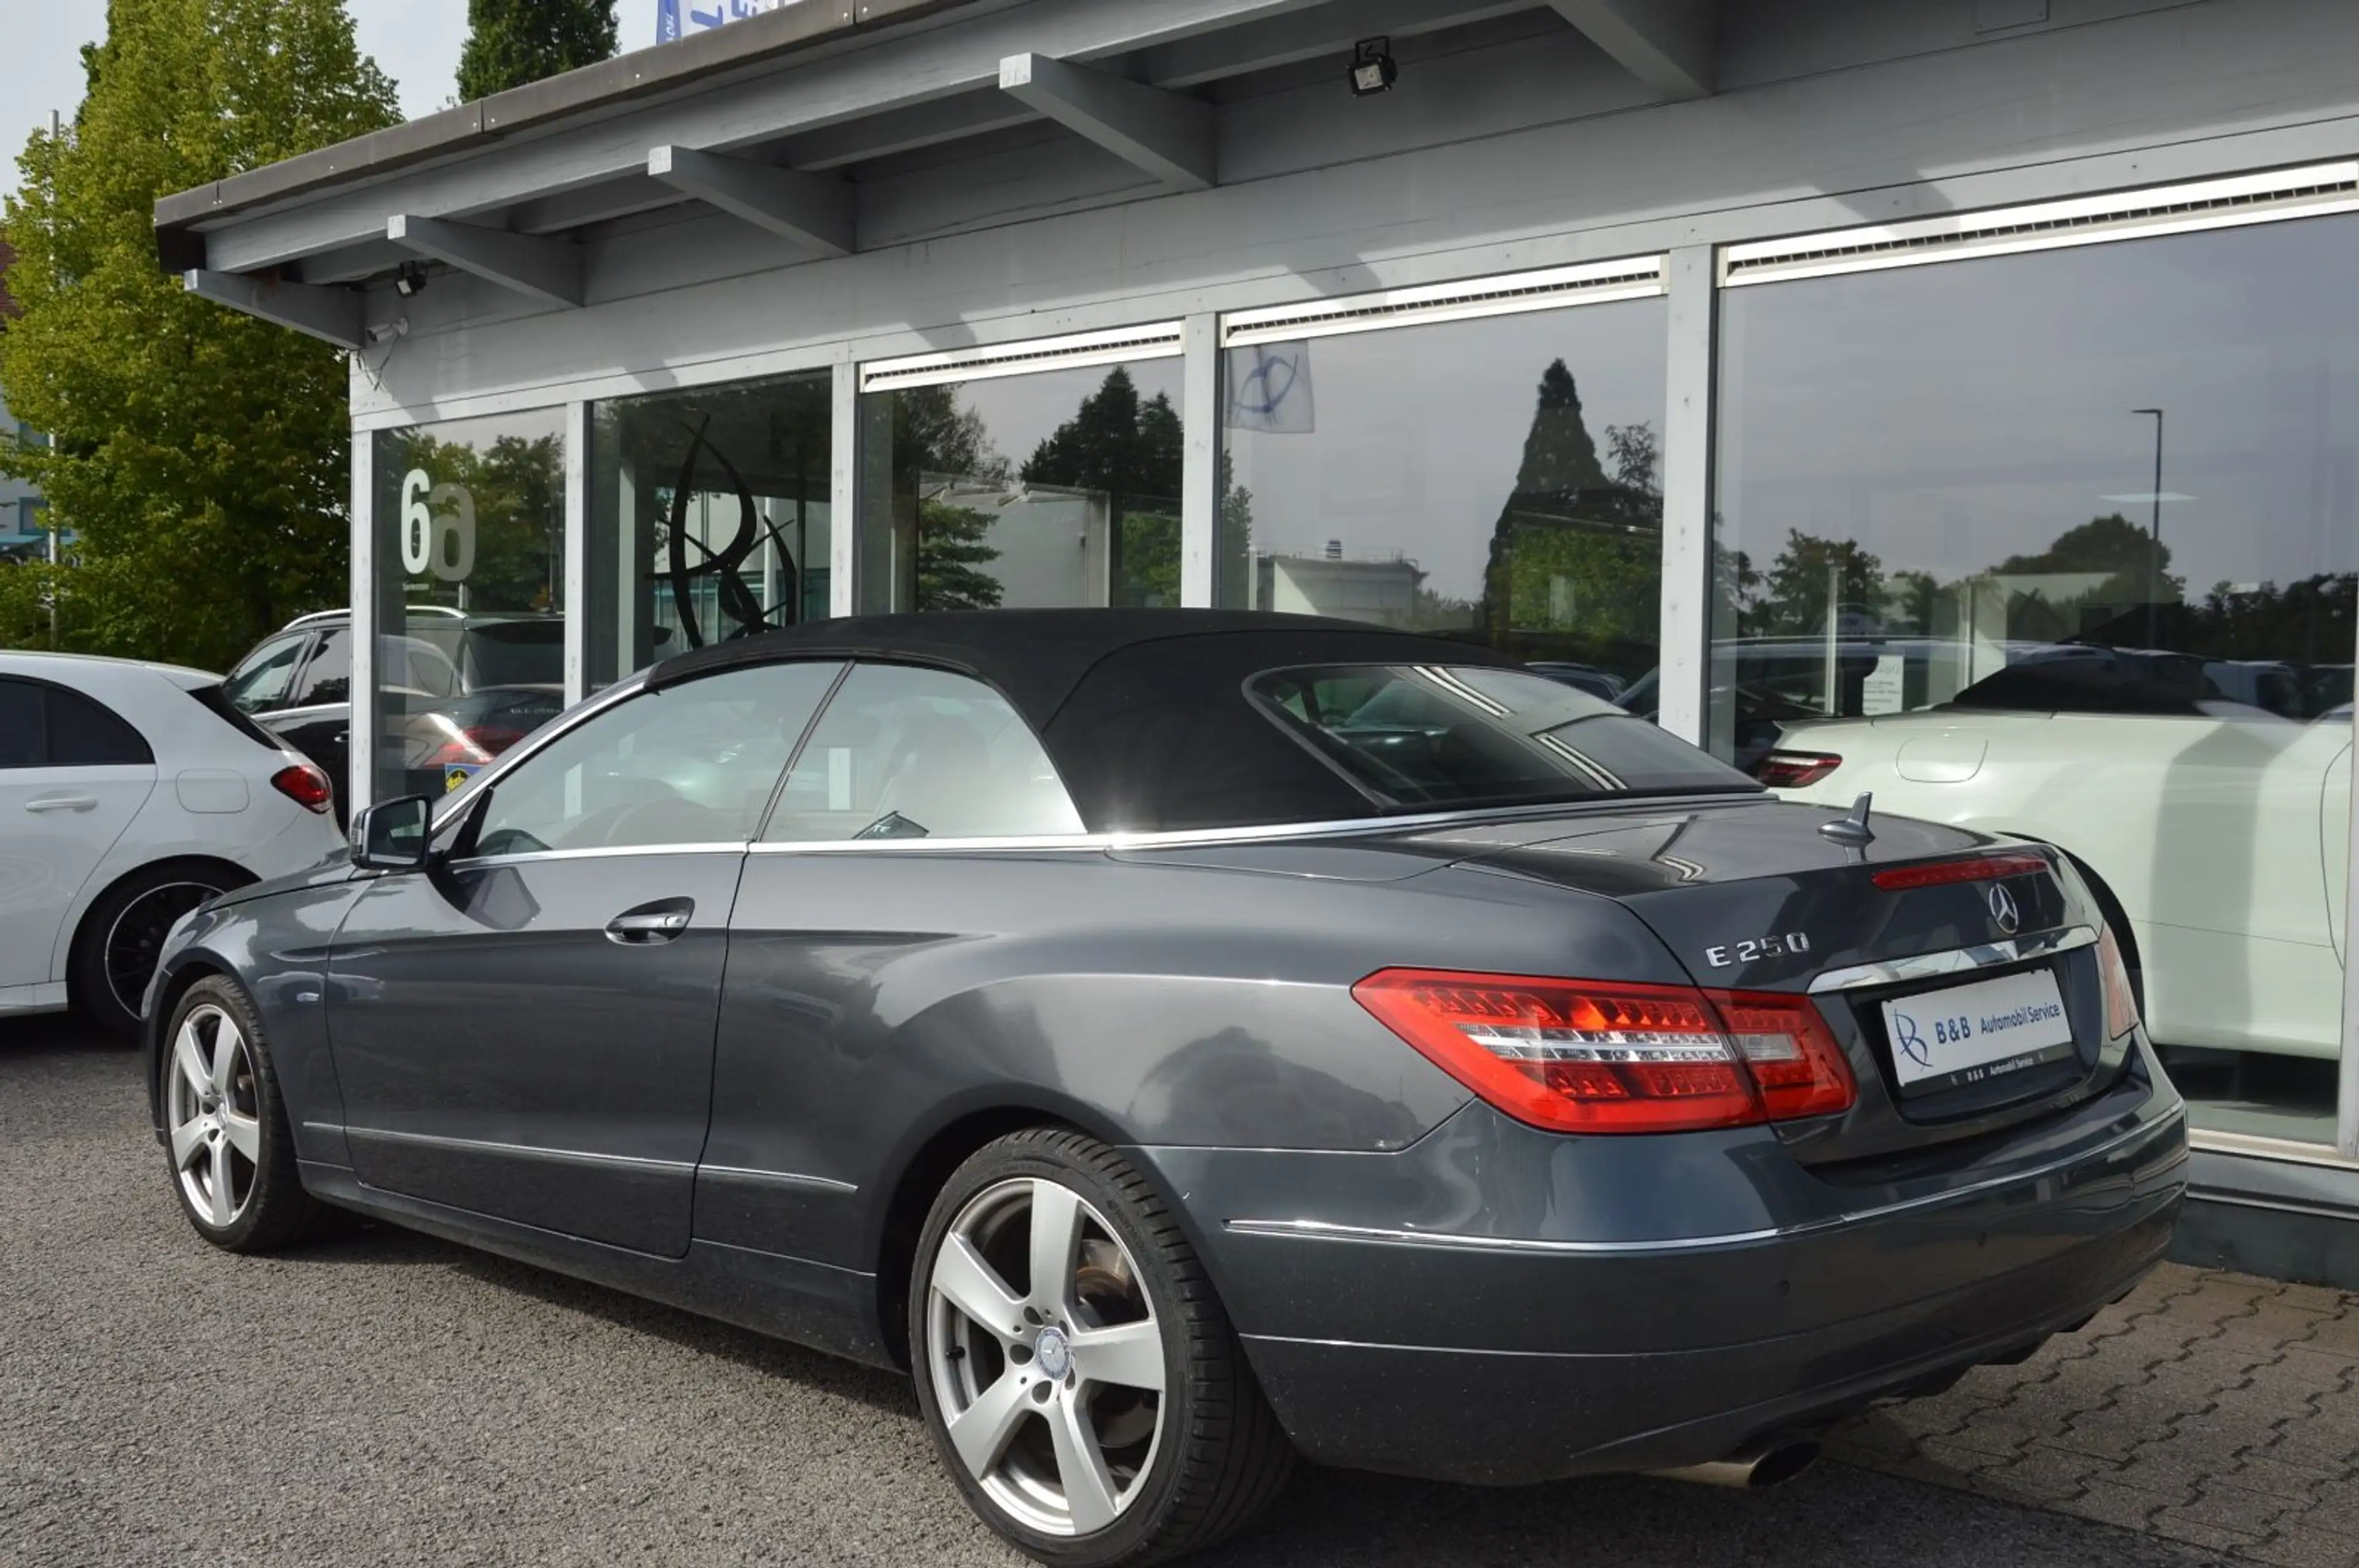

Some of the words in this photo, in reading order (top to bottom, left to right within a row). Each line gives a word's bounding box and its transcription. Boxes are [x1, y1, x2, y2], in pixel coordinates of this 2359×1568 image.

[401, 468, 430, 574] 6
[1705, 946, 1732, 968] E
[1737, 932, 1810, 963] 250
[1981, 1007, 2028, 1035] Automobil
[2027, 1002, 2060, 1023] Service
